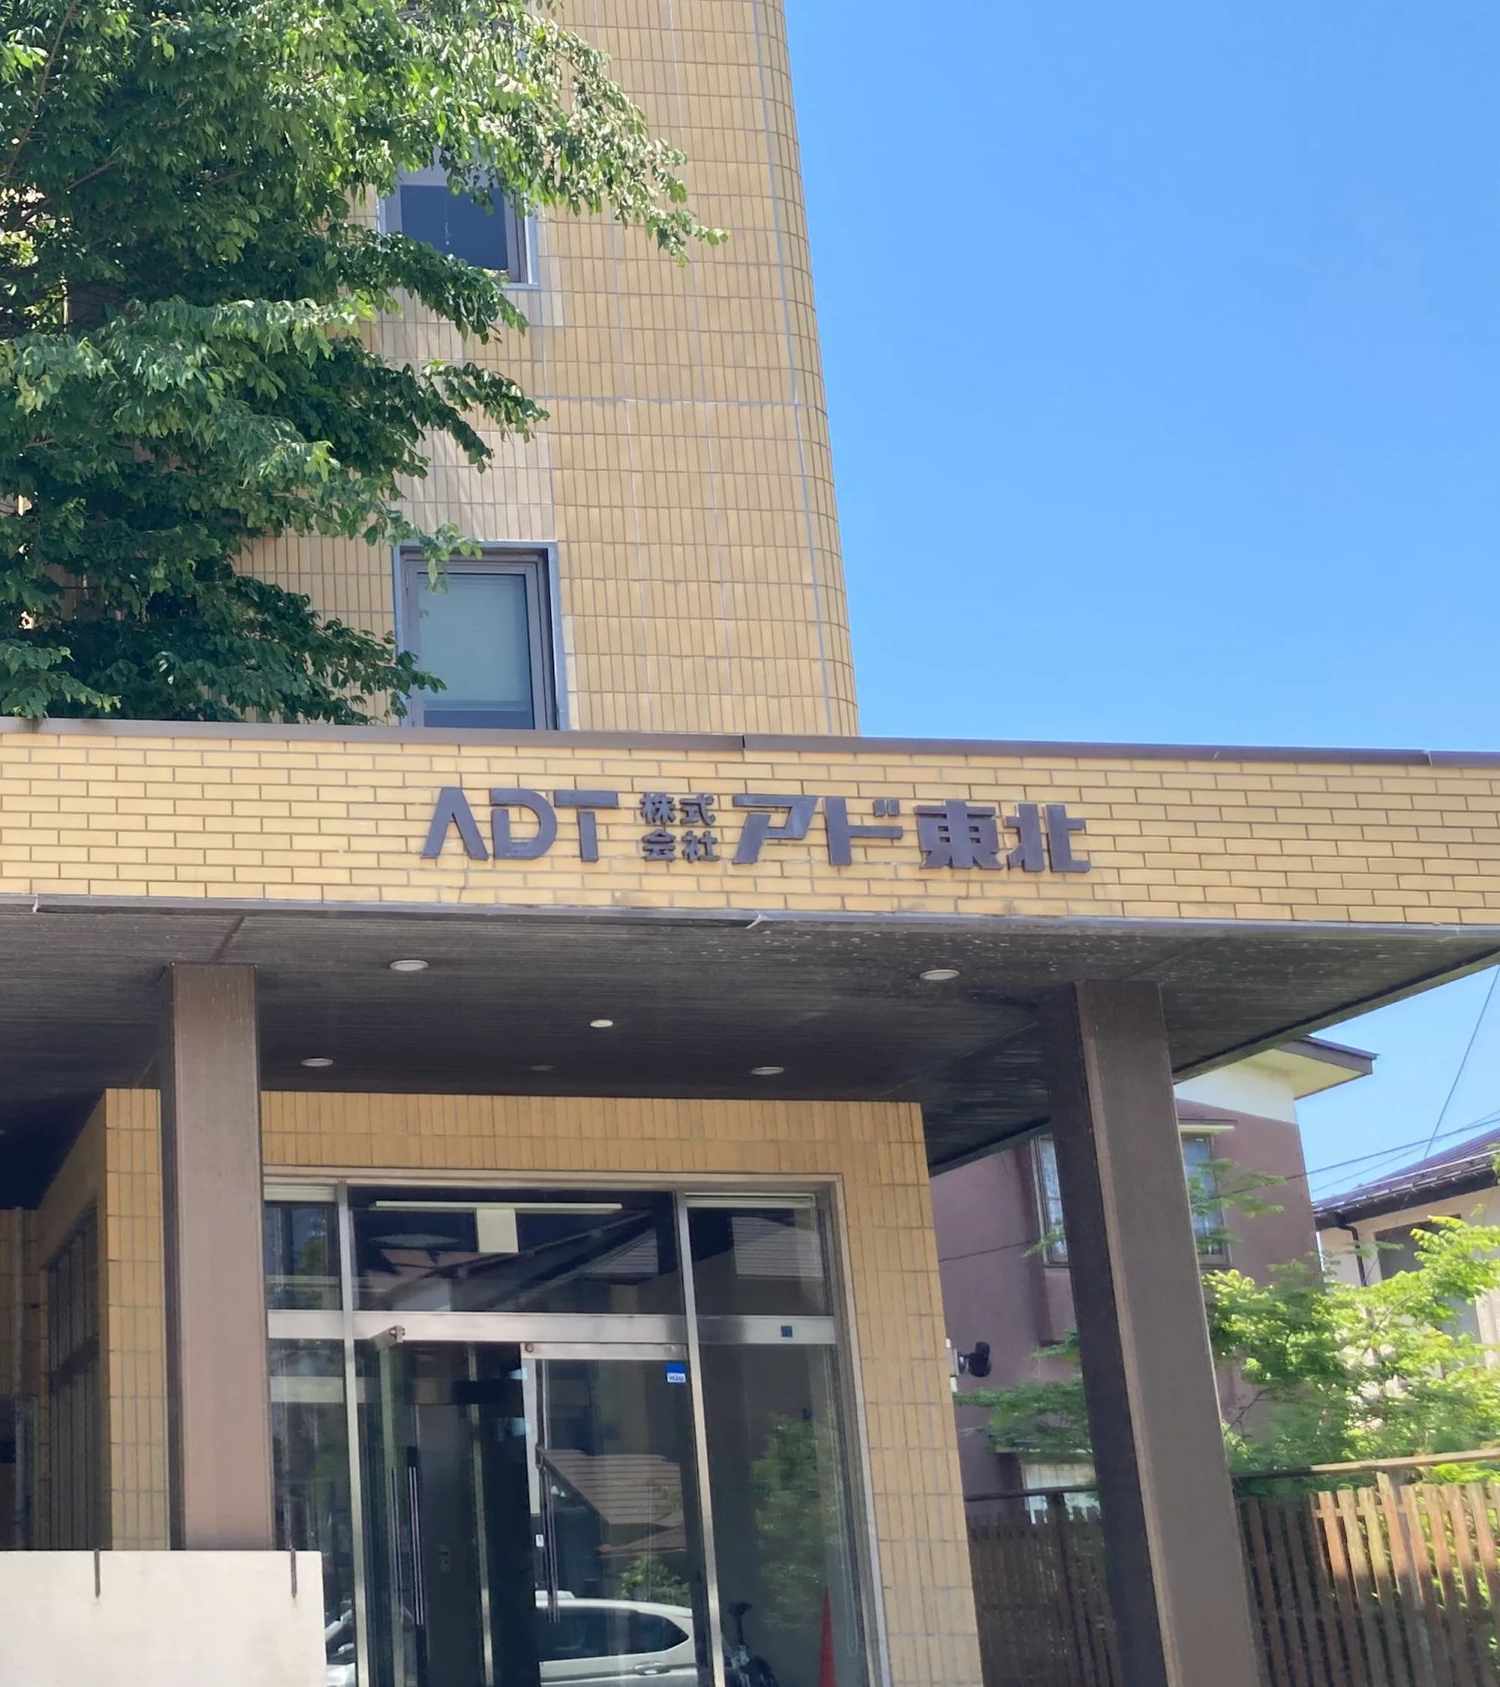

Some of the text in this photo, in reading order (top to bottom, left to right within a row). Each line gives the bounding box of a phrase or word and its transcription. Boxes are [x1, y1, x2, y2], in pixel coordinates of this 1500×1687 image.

[639, 792, 716, 826] 株式
[641, 828, 720, 864] 会社
[731, 793, 1092, 874] アド東北
